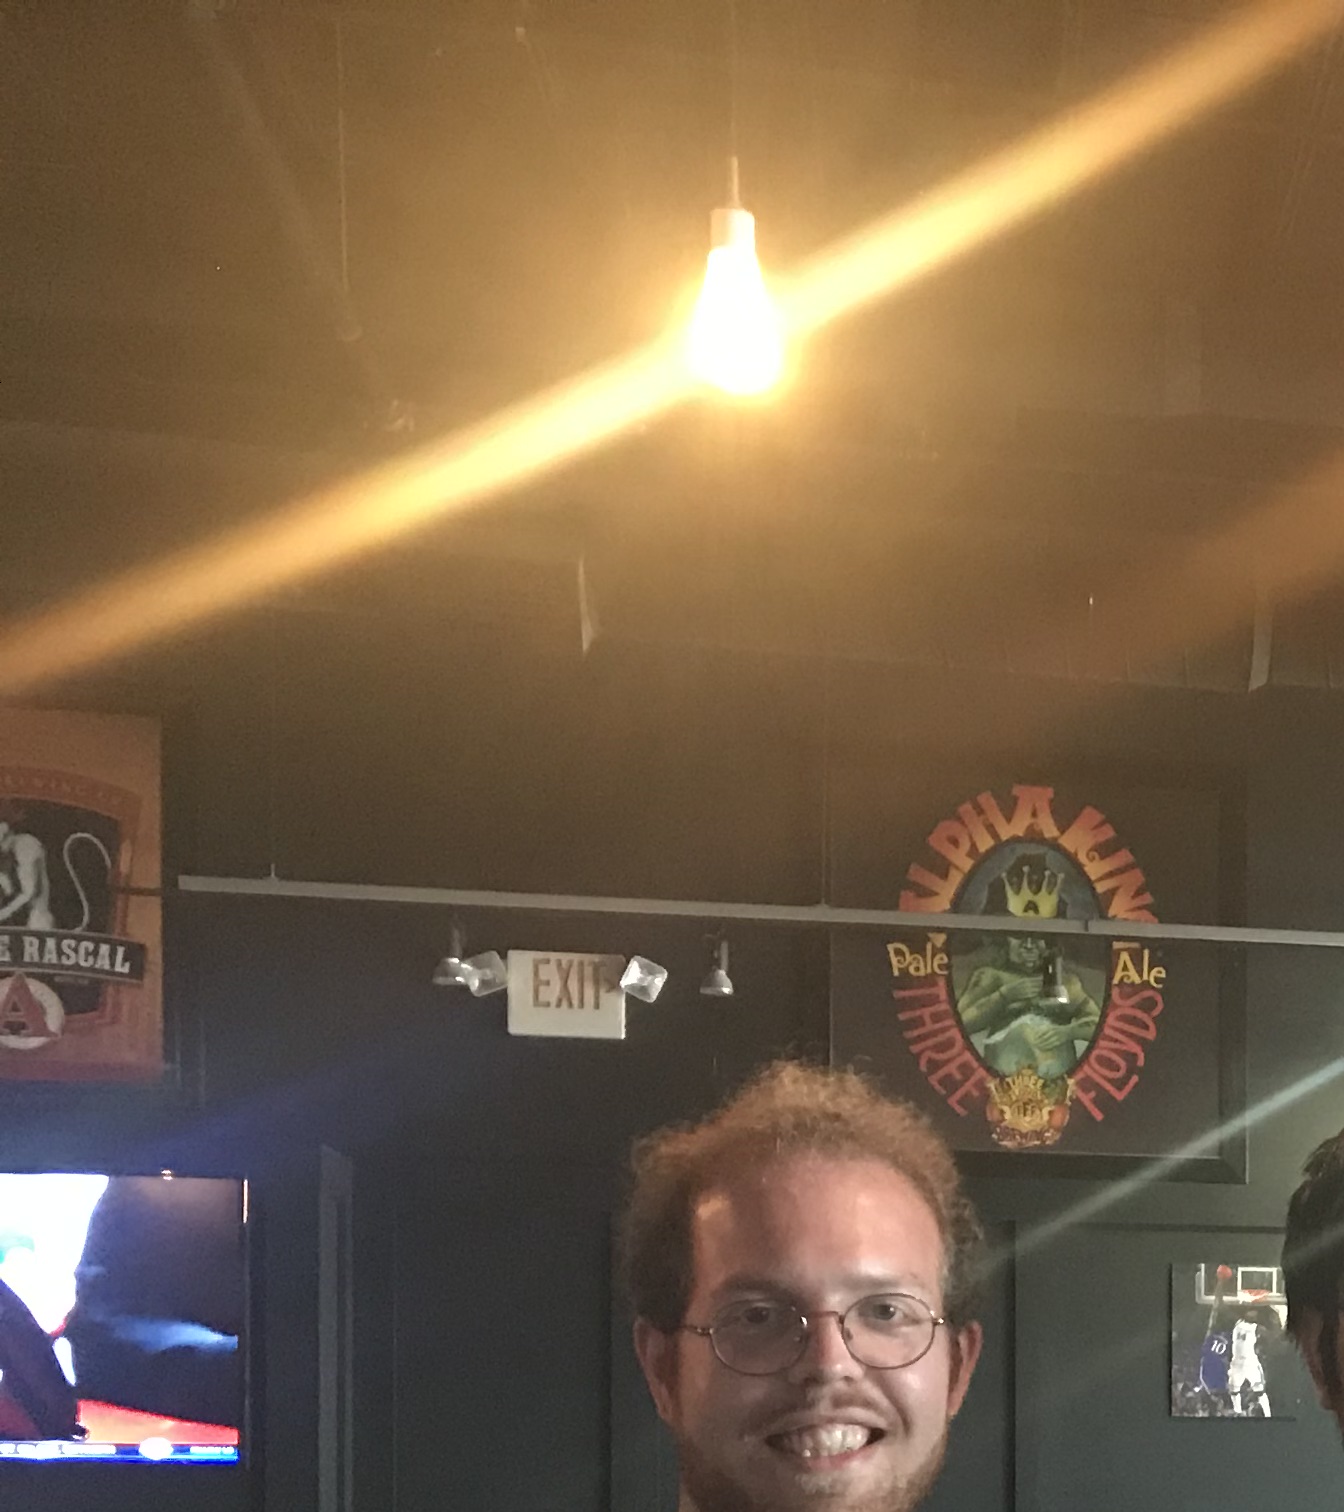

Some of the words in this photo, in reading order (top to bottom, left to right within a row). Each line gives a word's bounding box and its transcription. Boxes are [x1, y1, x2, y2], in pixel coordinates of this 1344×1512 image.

[23, 936, 131, 973] RASCAL
[887, 941, 949, 977] Pale
[1112, 948, 1167, 988] Ale
[533, 958, 606, 1010] EXIT
[893, 978, 993, 1117] THREE
[1068, 988, 1165, 1122] FLOYDS
